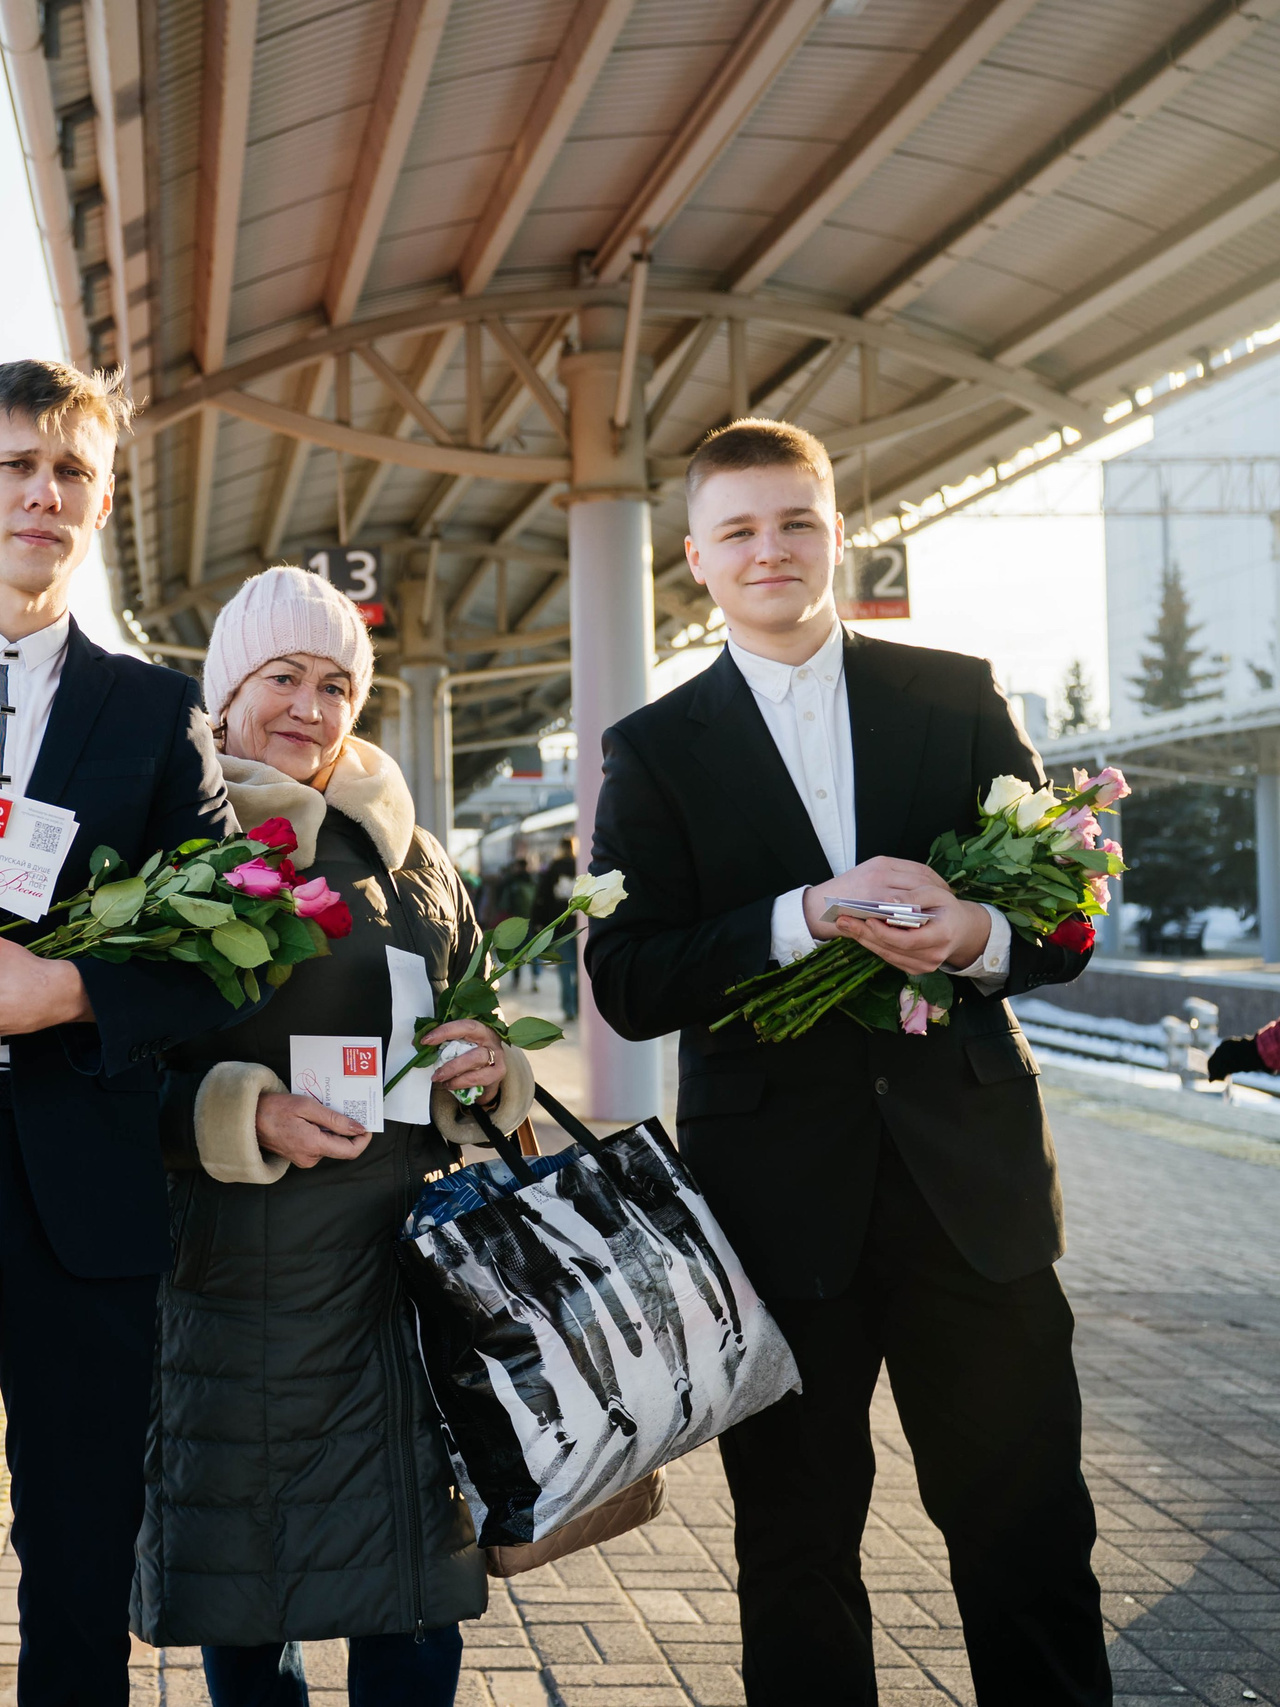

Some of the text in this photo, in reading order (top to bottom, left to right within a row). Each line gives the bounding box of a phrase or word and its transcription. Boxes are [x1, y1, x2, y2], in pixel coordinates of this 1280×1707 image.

[0, 854, 26, 867] ПУСКАЙ
[32, 864, 51, 875] ДУШЕ
[359, 1051, 372, 1070] 20
